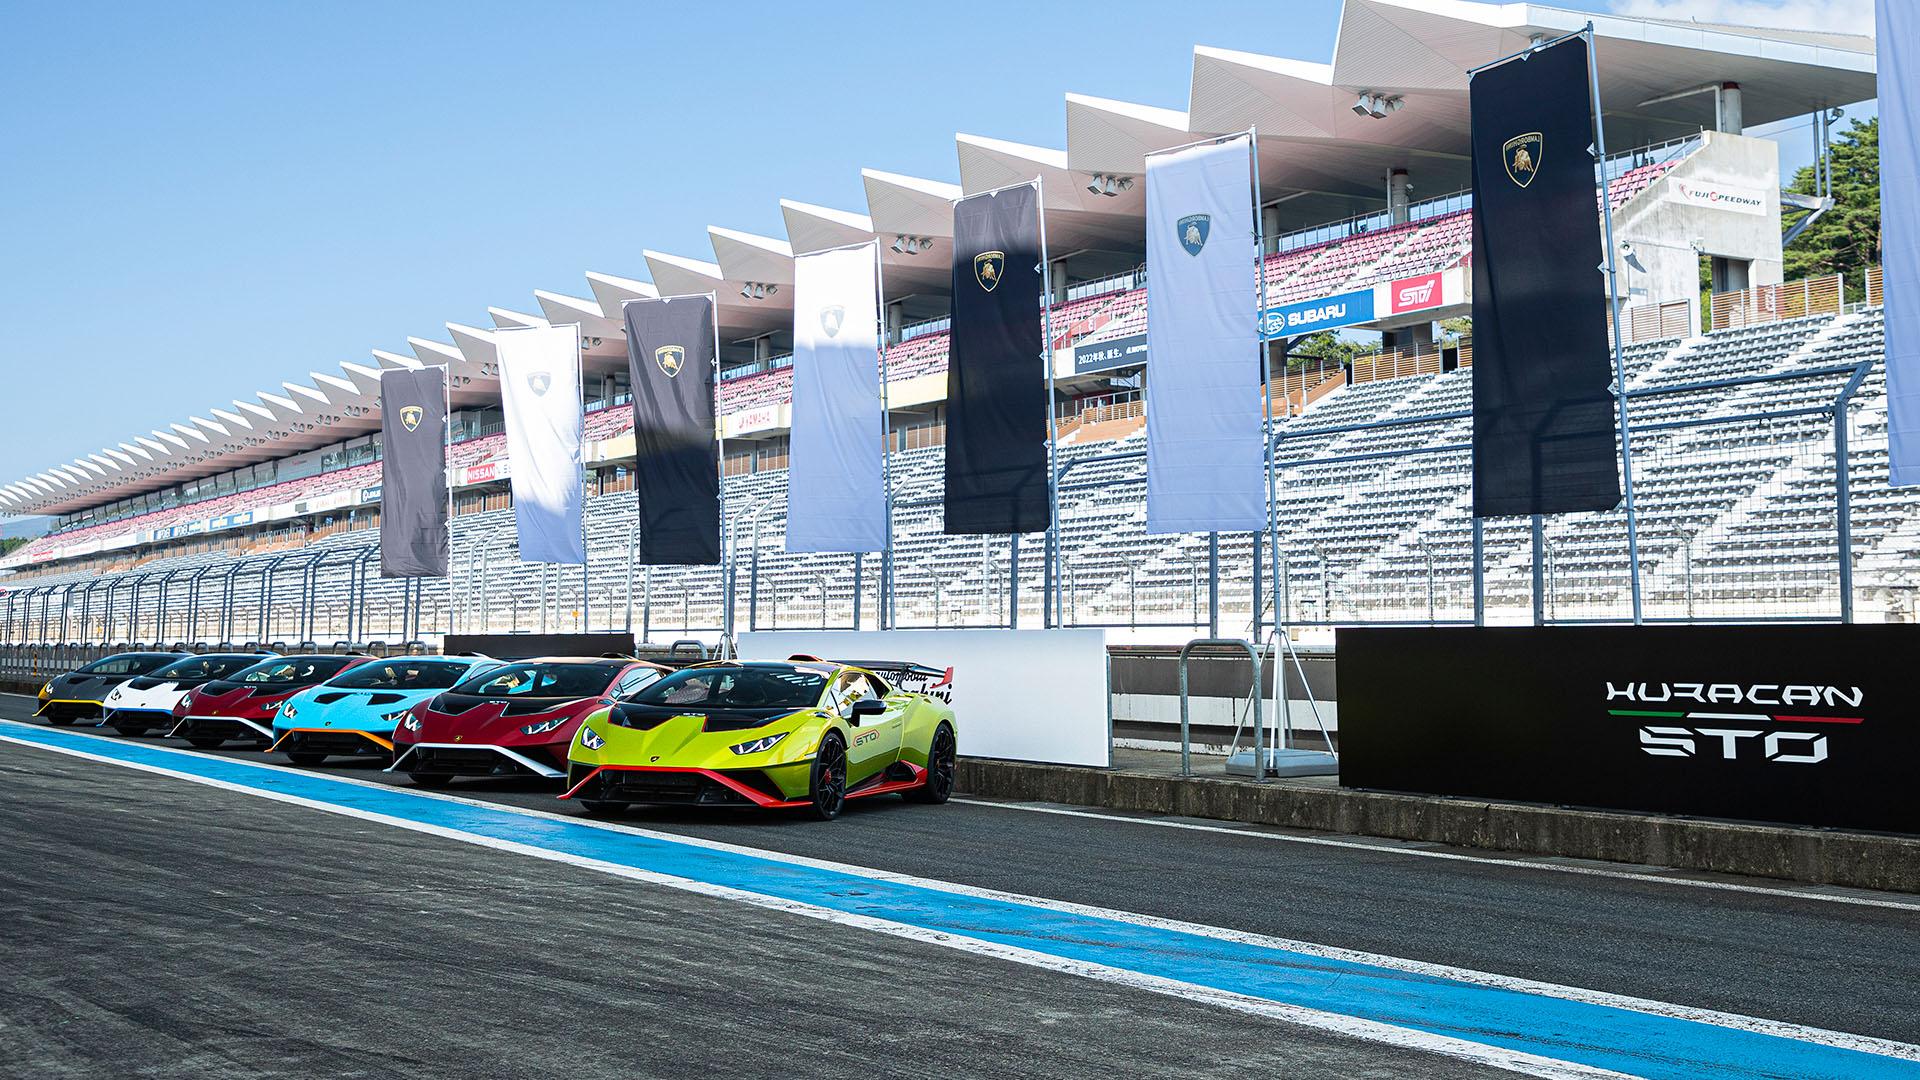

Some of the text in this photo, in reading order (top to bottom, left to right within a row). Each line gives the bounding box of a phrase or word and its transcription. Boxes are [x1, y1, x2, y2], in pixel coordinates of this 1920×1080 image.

[1287, 303, 1346, 327] SUBARU
[467, 465, 495, 481] NISSAN
[856, 732, 877, 746] STO
[1639, 725, 1828, 764] STO
